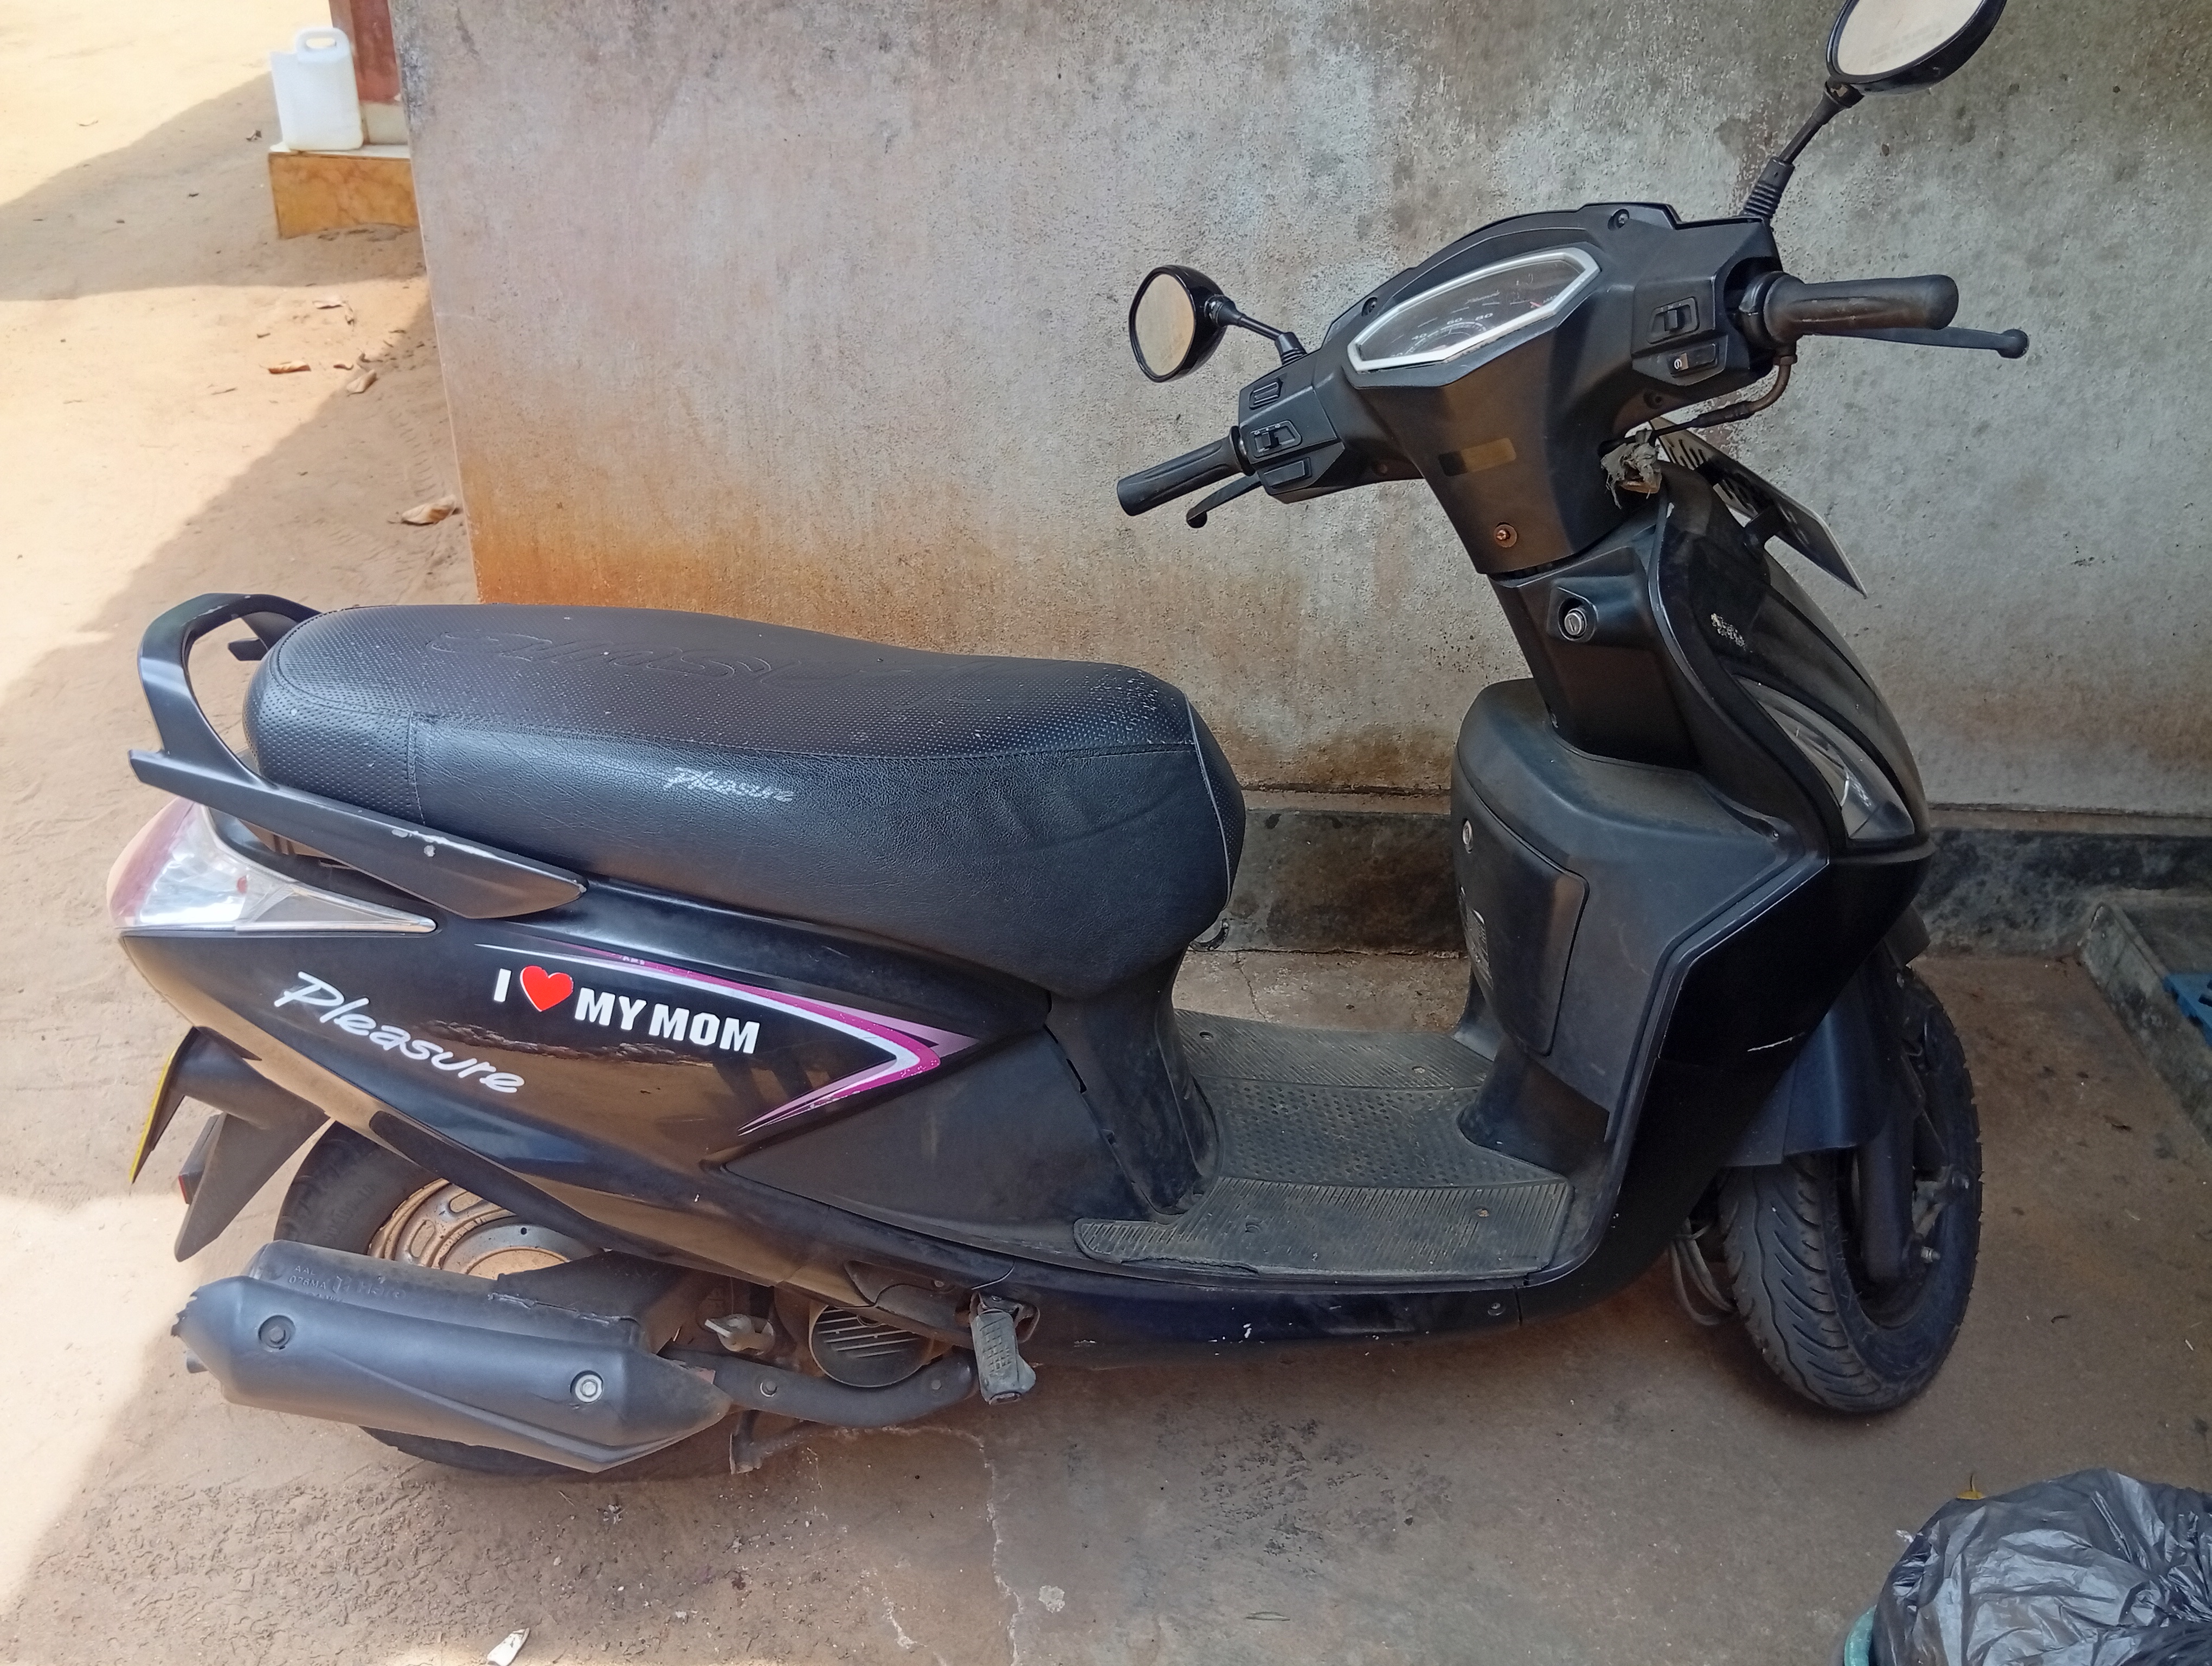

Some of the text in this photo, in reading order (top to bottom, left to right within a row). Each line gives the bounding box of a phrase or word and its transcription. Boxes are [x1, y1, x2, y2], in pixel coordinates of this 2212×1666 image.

[273, 971, 525, 1094] Pleasure
[493, 968, 760, 1054] I MY MOM
